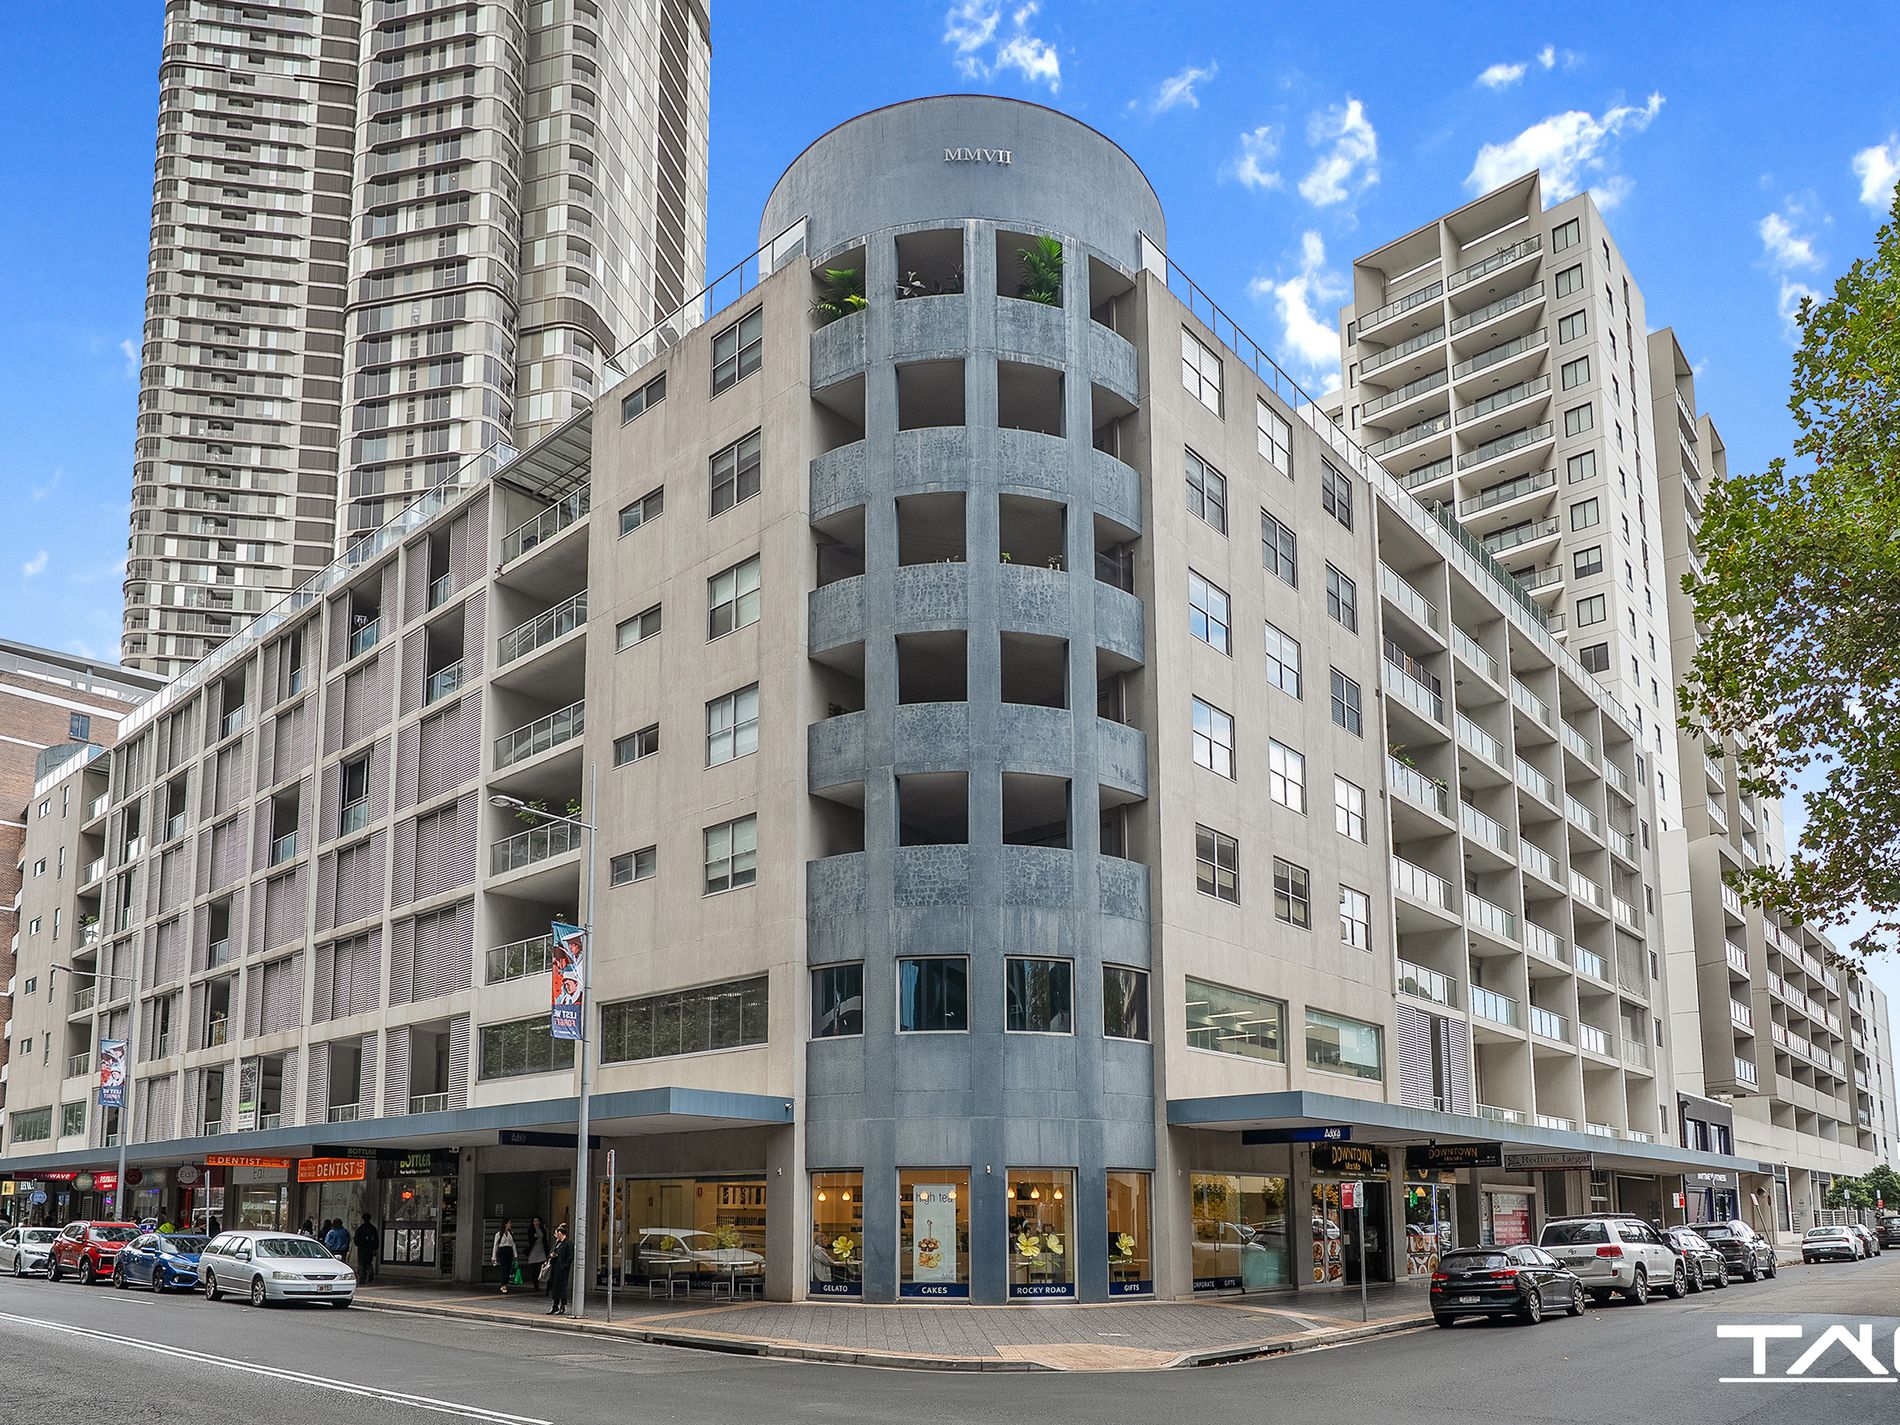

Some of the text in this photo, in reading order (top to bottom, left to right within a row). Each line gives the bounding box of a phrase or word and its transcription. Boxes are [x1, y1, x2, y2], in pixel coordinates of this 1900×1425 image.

[944, 147, 1012, 165] MMVII
[1331, 1146, 1373, 1167] DOWNTOWN
[1428, 1147, 1478, 1160] DOWNTOWN
[217, 1157, 261, 1166] DENTIST
[1521, 1153, 1590, 1165] Redline Legal
[317, 1162, 355, 1177] DENTIST
[823, 1283, 849, 1292] GELATO
[921, 1286, 948, 1294] CAKES
[1016, 1286, 1067, 1295] ROCKY ROAD
[1123, 1283, 1140, 1292] GIFTS
